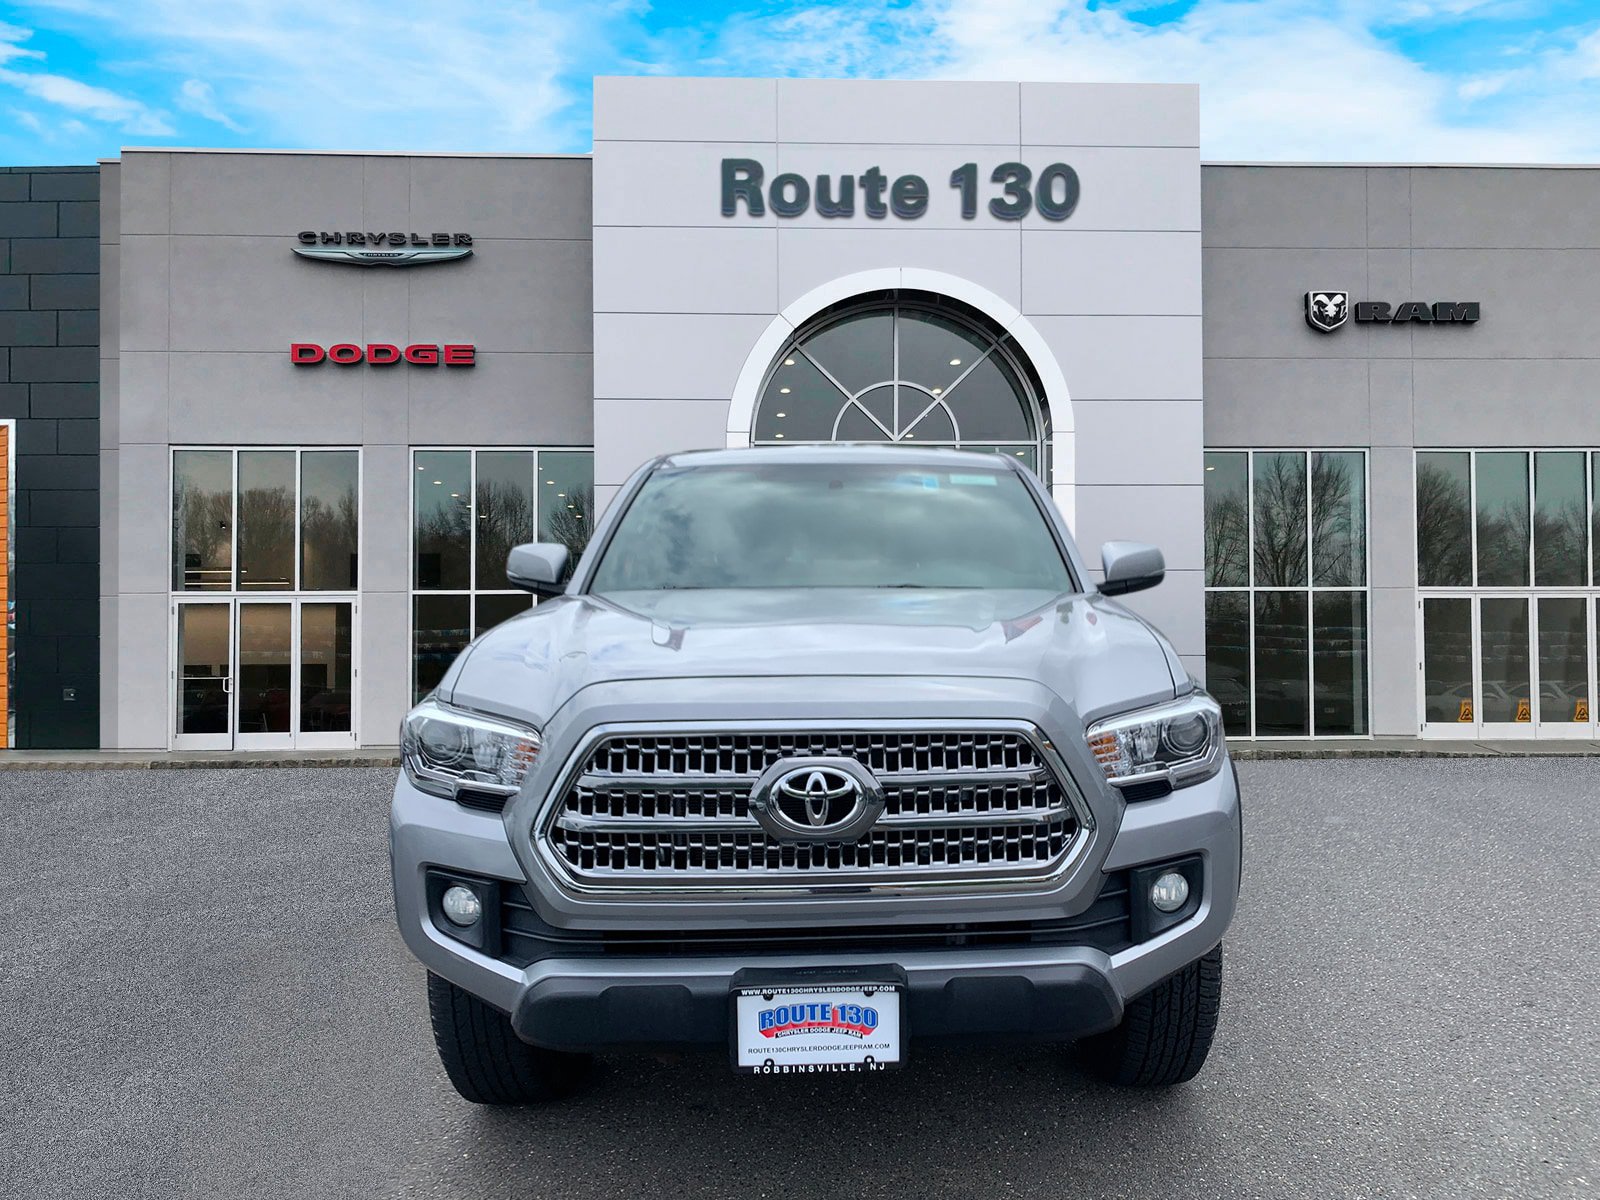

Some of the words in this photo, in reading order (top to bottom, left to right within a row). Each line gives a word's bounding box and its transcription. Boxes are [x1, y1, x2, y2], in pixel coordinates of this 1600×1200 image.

[721, 158, 929, 219] Route
[949, 161, 1080, 221] 130
[298, 231, 473, 245] CHRYSLER
[1355, 302, 1480, 323] RAM
[291, 343, 475, 366] DODGE
[741, 986, 895, 996] WWW.ROUTE130CHRYSLERDODGEJEEP.COM
[759, 1002, 832, 1030] ROUTE
[837, 1003, 878, 1028] 130
[748, 1043, 890, 1054] ROUTE130CHRYSLERDODGEJEEPRAM.COM
[870, 1062, 885, 1071] NJ
